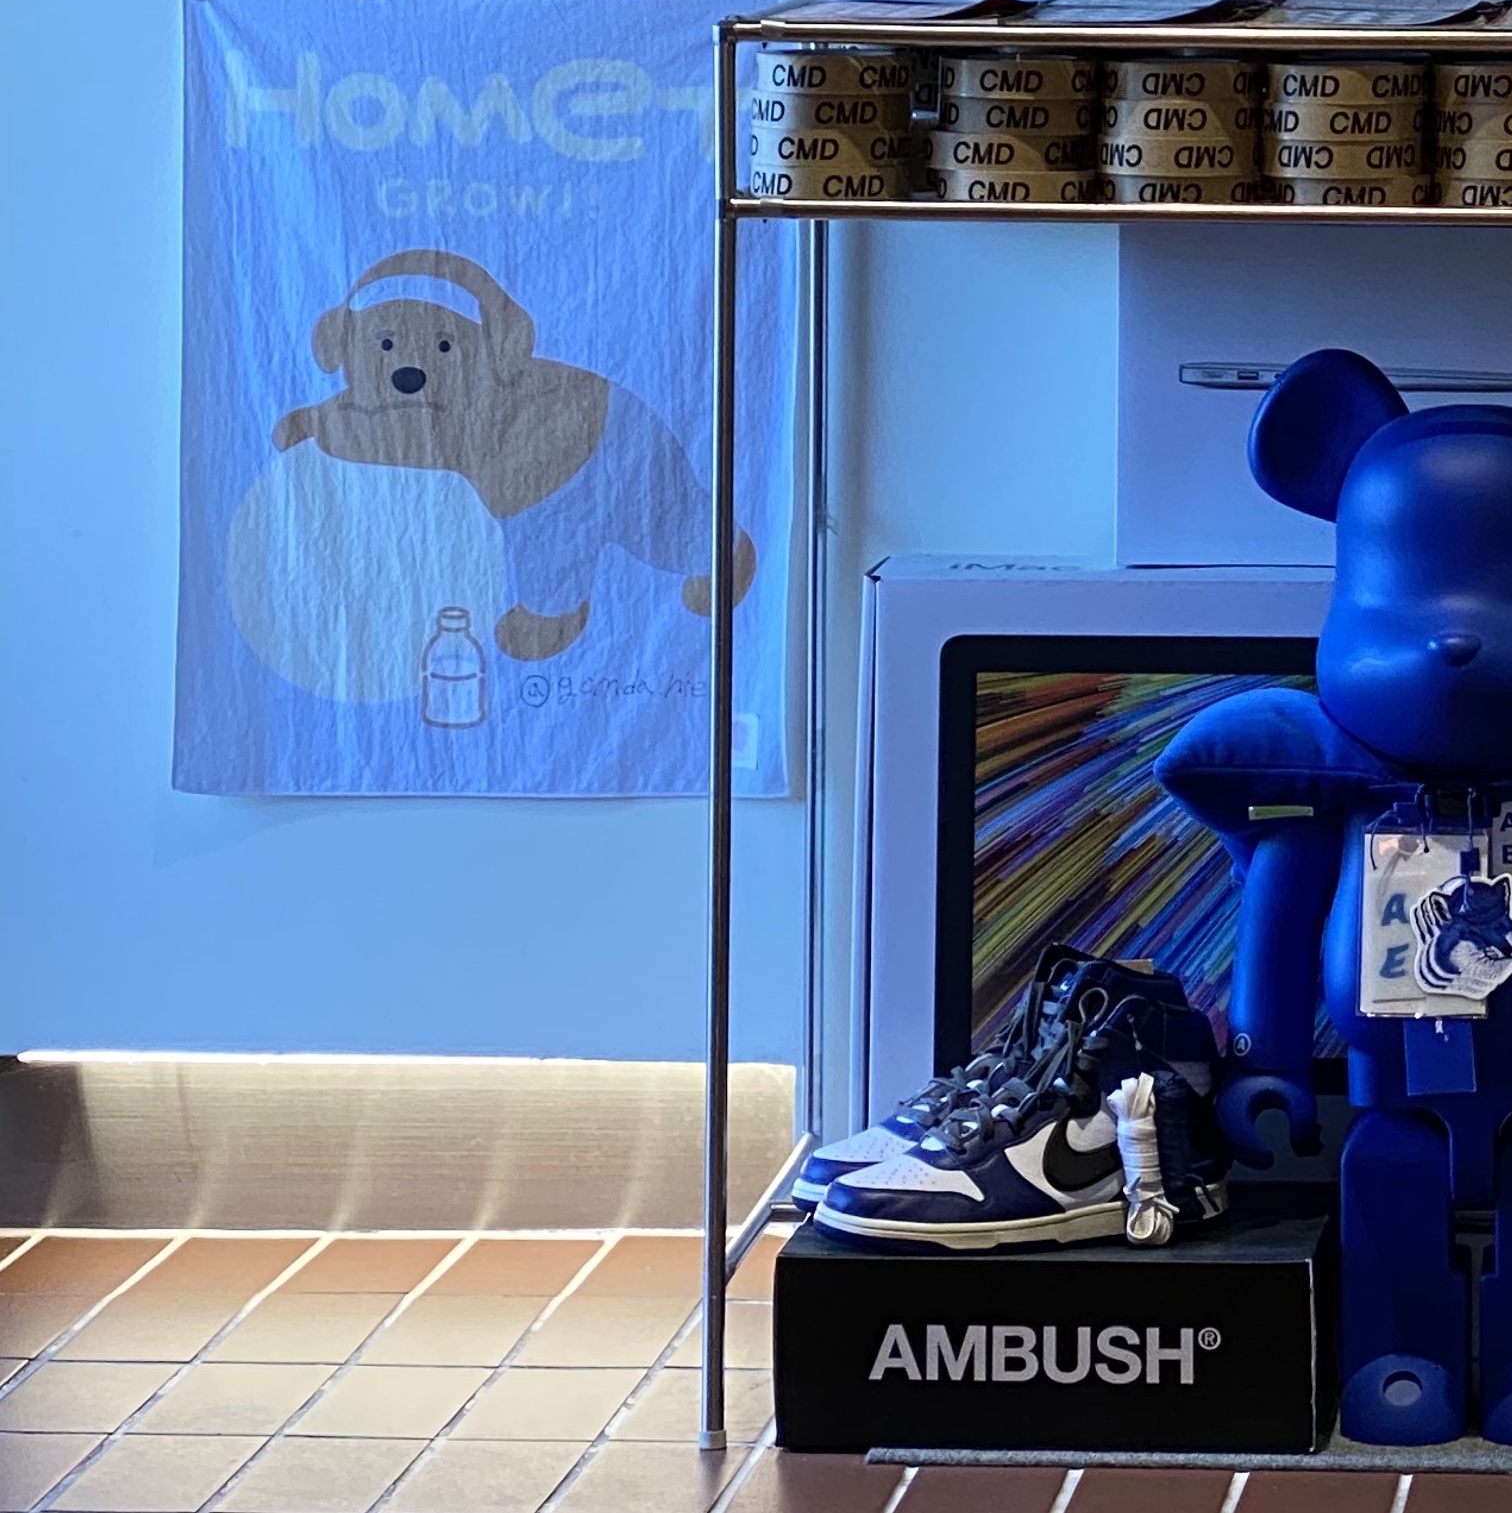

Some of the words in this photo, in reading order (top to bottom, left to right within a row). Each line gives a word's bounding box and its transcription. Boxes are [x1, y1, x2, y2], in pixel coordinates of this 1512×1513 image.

[772, 64, 826, 87] CMD
[859, 65, 909, 89] CMD
[979, 69, 1043, 94] CMD
[1142, 73, 1205, 95] CMD
[1283, 75, 1339, 97] CMD
[1372, 75, 1423, 96] CMD
[1454, 74, 1512, 98] CMD
[752, 101, 784, 121] CMD
[815, 102, 877, 124] CMD
[986, 106, 1050, 128] CMD
[1144, 108, 1207, 130] CMD
[1330, 112, 1392, 134] CMD
[778, 137, 839, 160] CMD
[953, 141, 1015, 165] CMD
[1175, 145, 1234, 168] CMD
[1278, 146, 1333, 169] CMD
[1367, 145, 1415, 167] CMD
[752, 171, 792, 194] CMD
[823, 175, 884, 197] CMD
[968, 180, 1030, 201] CMD
[1323, 186, 1385, 205] CMD
[949, 562, 1081, 572] iMac
[1382, 893, 1410, 926] A
[1380, 944, 1408, 978] E
